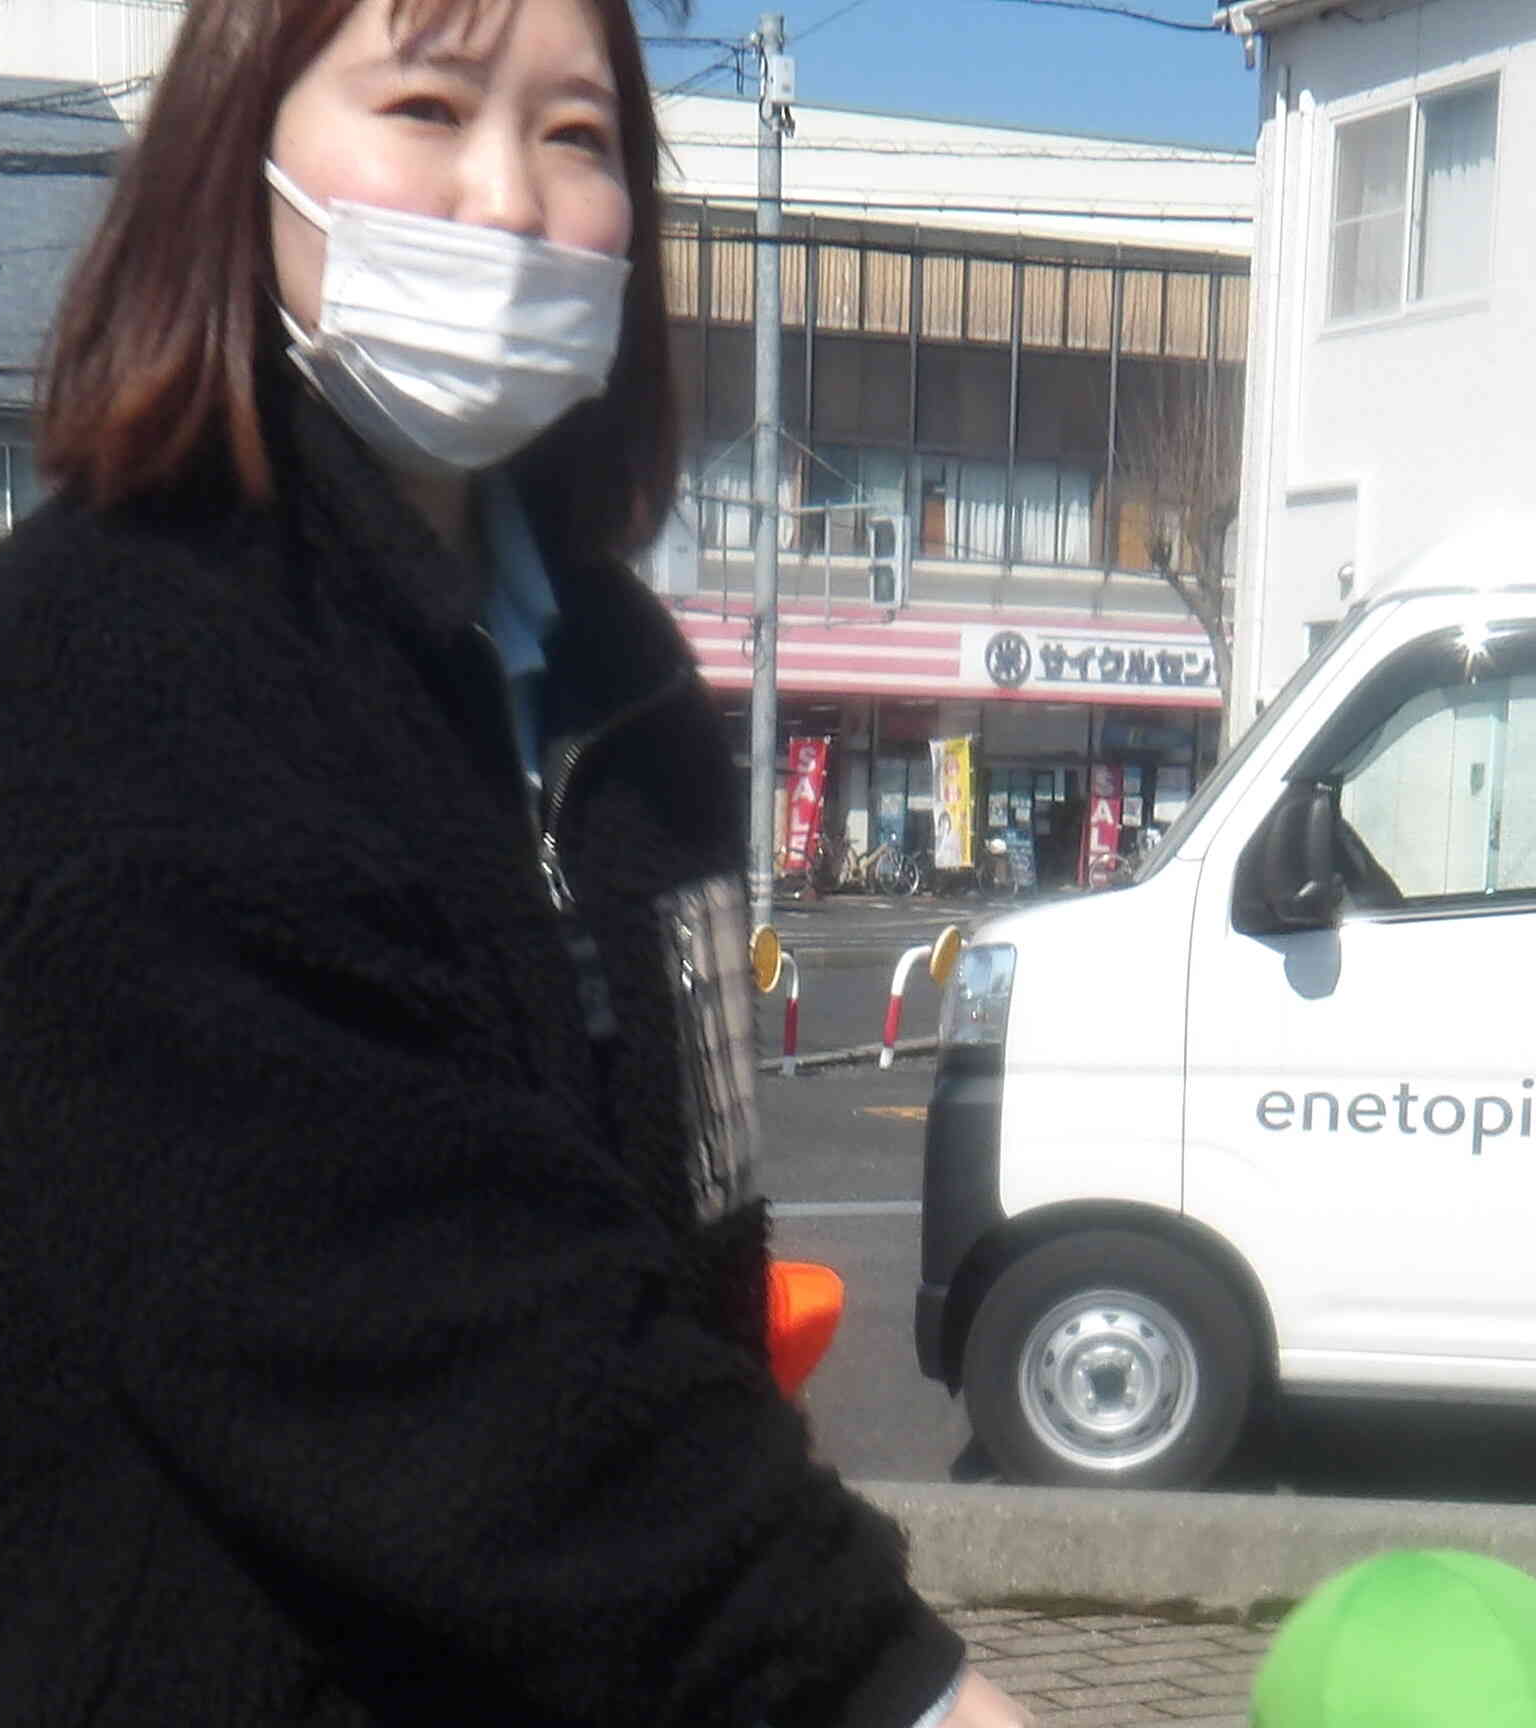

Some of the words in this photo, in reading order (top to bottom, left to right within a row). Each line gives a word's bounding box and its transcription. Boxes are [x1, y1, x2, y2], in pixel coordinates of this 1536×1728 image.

[1039, 642, 1221, 687] サイクルセン
[790, 745, 817, 861] SALE
